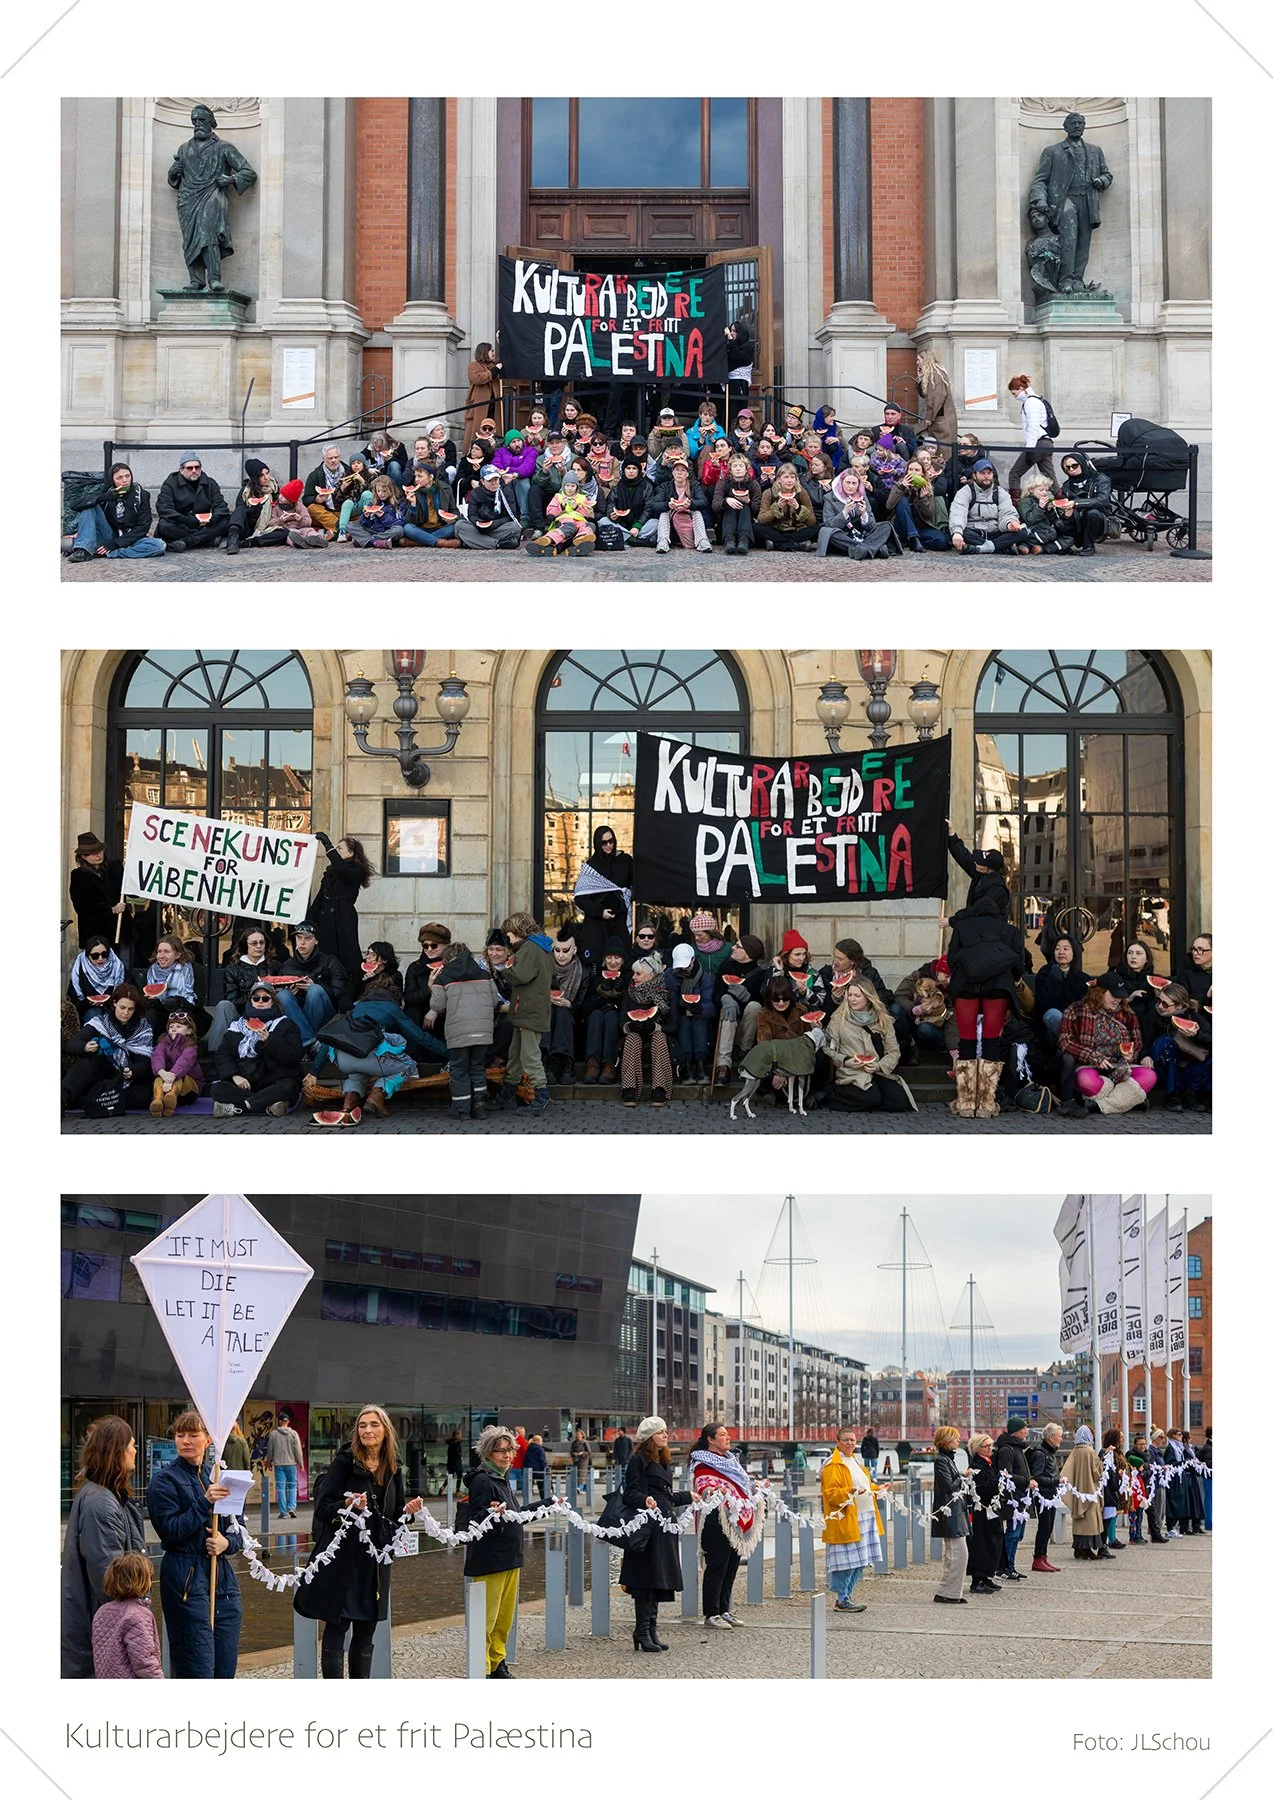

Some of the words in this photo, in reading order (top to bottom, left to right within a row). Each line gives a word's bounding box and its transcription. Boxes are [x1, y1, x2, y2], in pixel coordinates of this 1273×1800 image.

[592, 318, 617, 333] FOR
[622, 318, 642, 332] ET
[649, 317, 682, 333] FRITT
[544, 317, 704, 379] PALESTINA
[760, 819, 794, 838] FOR
[801, 816, 827, 835] ET
[837, 812, 882, 834] FRITT
[142, 814, 308, 868] SCENEKUNST
[203, 856, 239, 876] FOR
[695, 819, 914, 898] PALESTINA
[195, 1237, 204, 1258] I
[211, 1239, 258, 1259] MUST
[201, 1270, 237, 1292] DIE
[165, 1299, 196, 1318] LET
[201, 1302, 220, 1320] IT
[233, 1303, 255, 1321] BE
[201, 1325, 215, 1347] A
